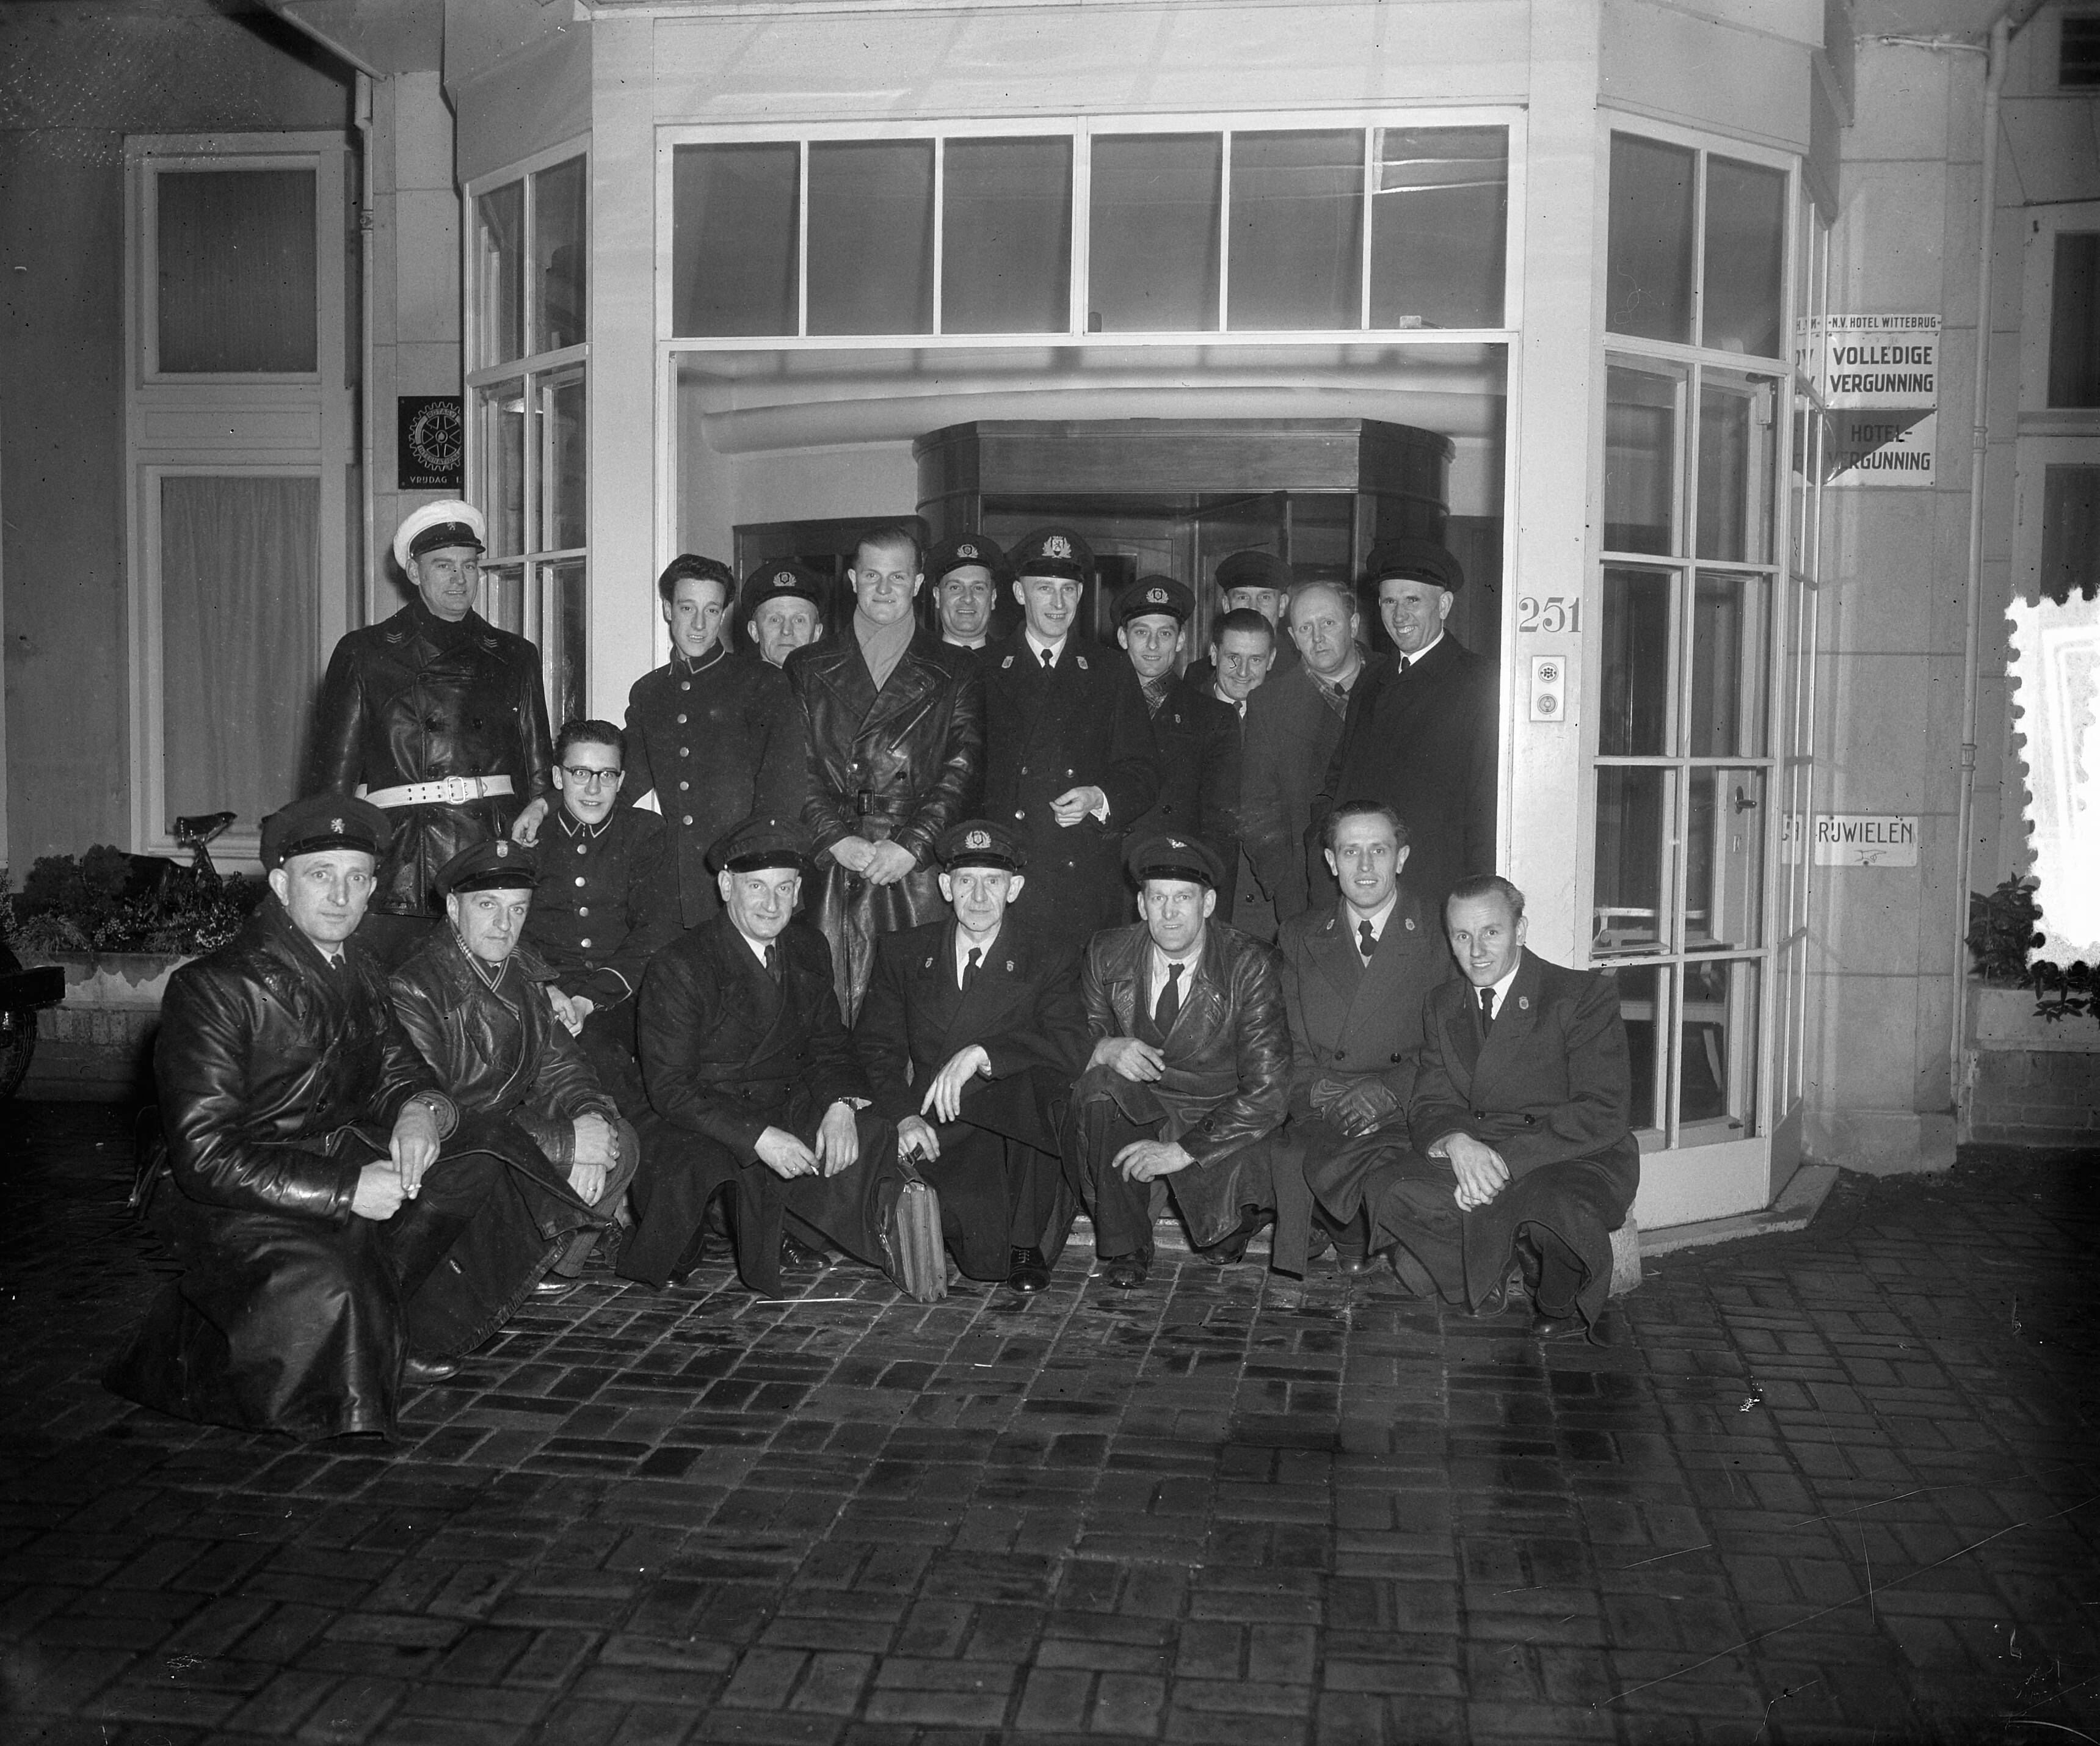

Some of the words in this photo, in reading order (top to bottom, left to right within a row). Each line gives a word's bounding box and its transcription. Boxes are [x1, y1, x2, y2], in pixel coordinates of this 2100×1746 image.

[1833, 317, 1848, 329] N.V.
[1850, 317, 1879, 329] HOTEL
[1882, 316, 1936, 329] WITTEBRUG
[1833, 346, 1933, 365] VOLLEDIGE
[1830, 374, 1933, 392] VERGUNNING
[427, 408, 456, 418] ROTARY
[1827, 451, 1931, 470] VERGUNNING
[1519, 597, 1581, 632] 251
[1818, 821, 1913, 843] RIJWIELEN
